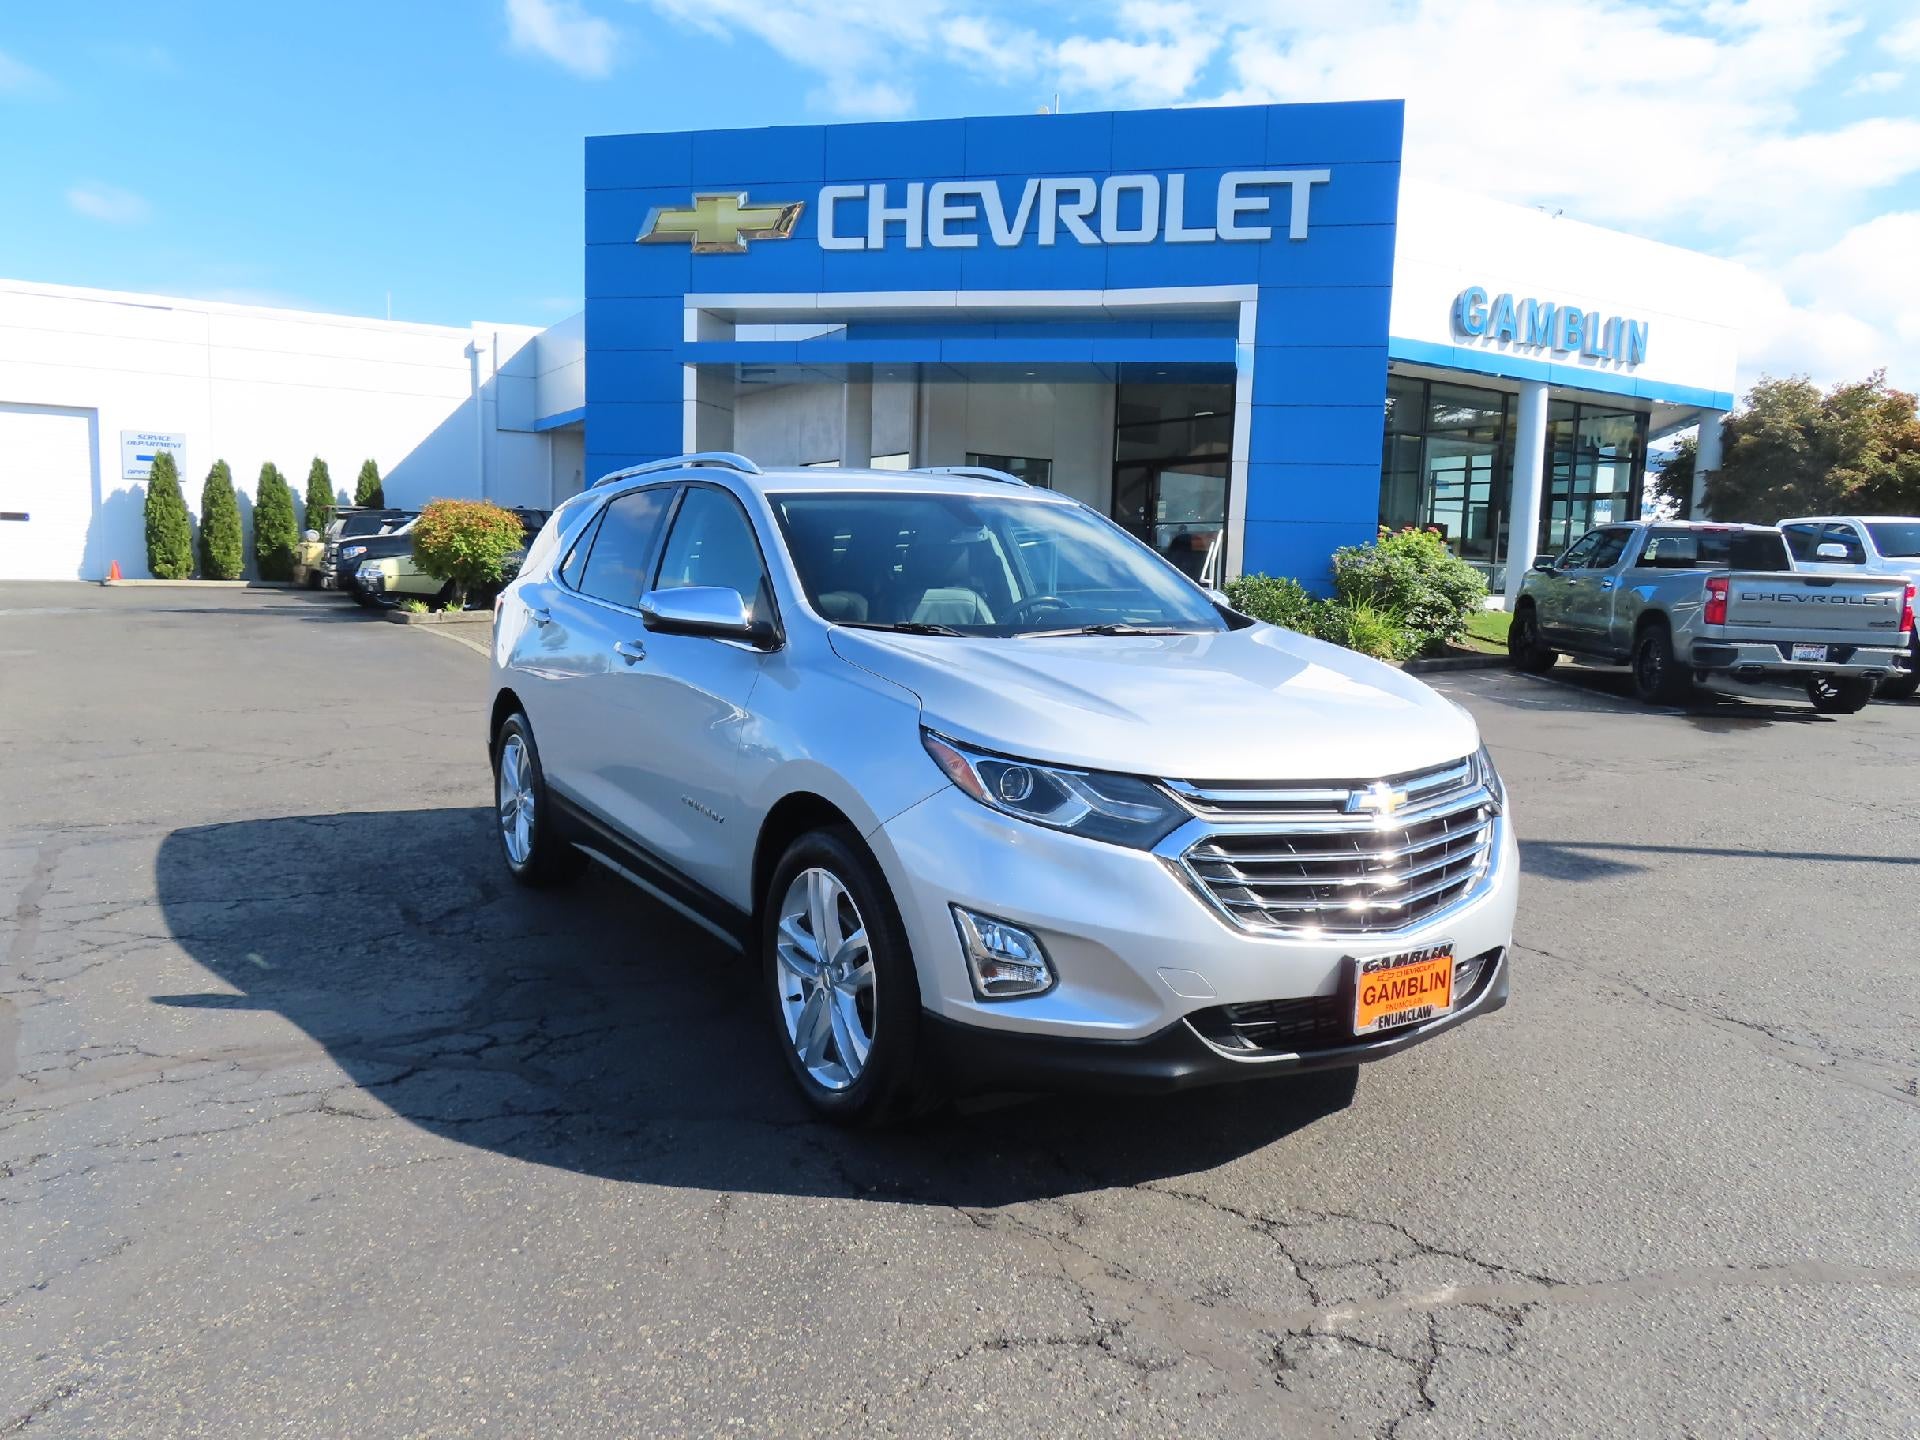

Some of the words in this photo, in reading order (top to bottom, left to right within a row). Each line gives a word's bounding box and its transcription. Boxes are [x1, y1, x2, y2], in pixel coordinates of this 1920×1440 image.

[817, 168, 1331, 250] CHEVROLET
[1450, 286, 1649, 365] GAMBLIN
[137, 433, 172, 442] SERVICE
[1741, 592, 1893, 607] CHEVROLET
[1362, 943, 1454, 973] GAMBLIN
[1363, 969, 1447, 1006] GAMBLIN
[1377, 1004, 1433, 1029] ENUMCLAW
